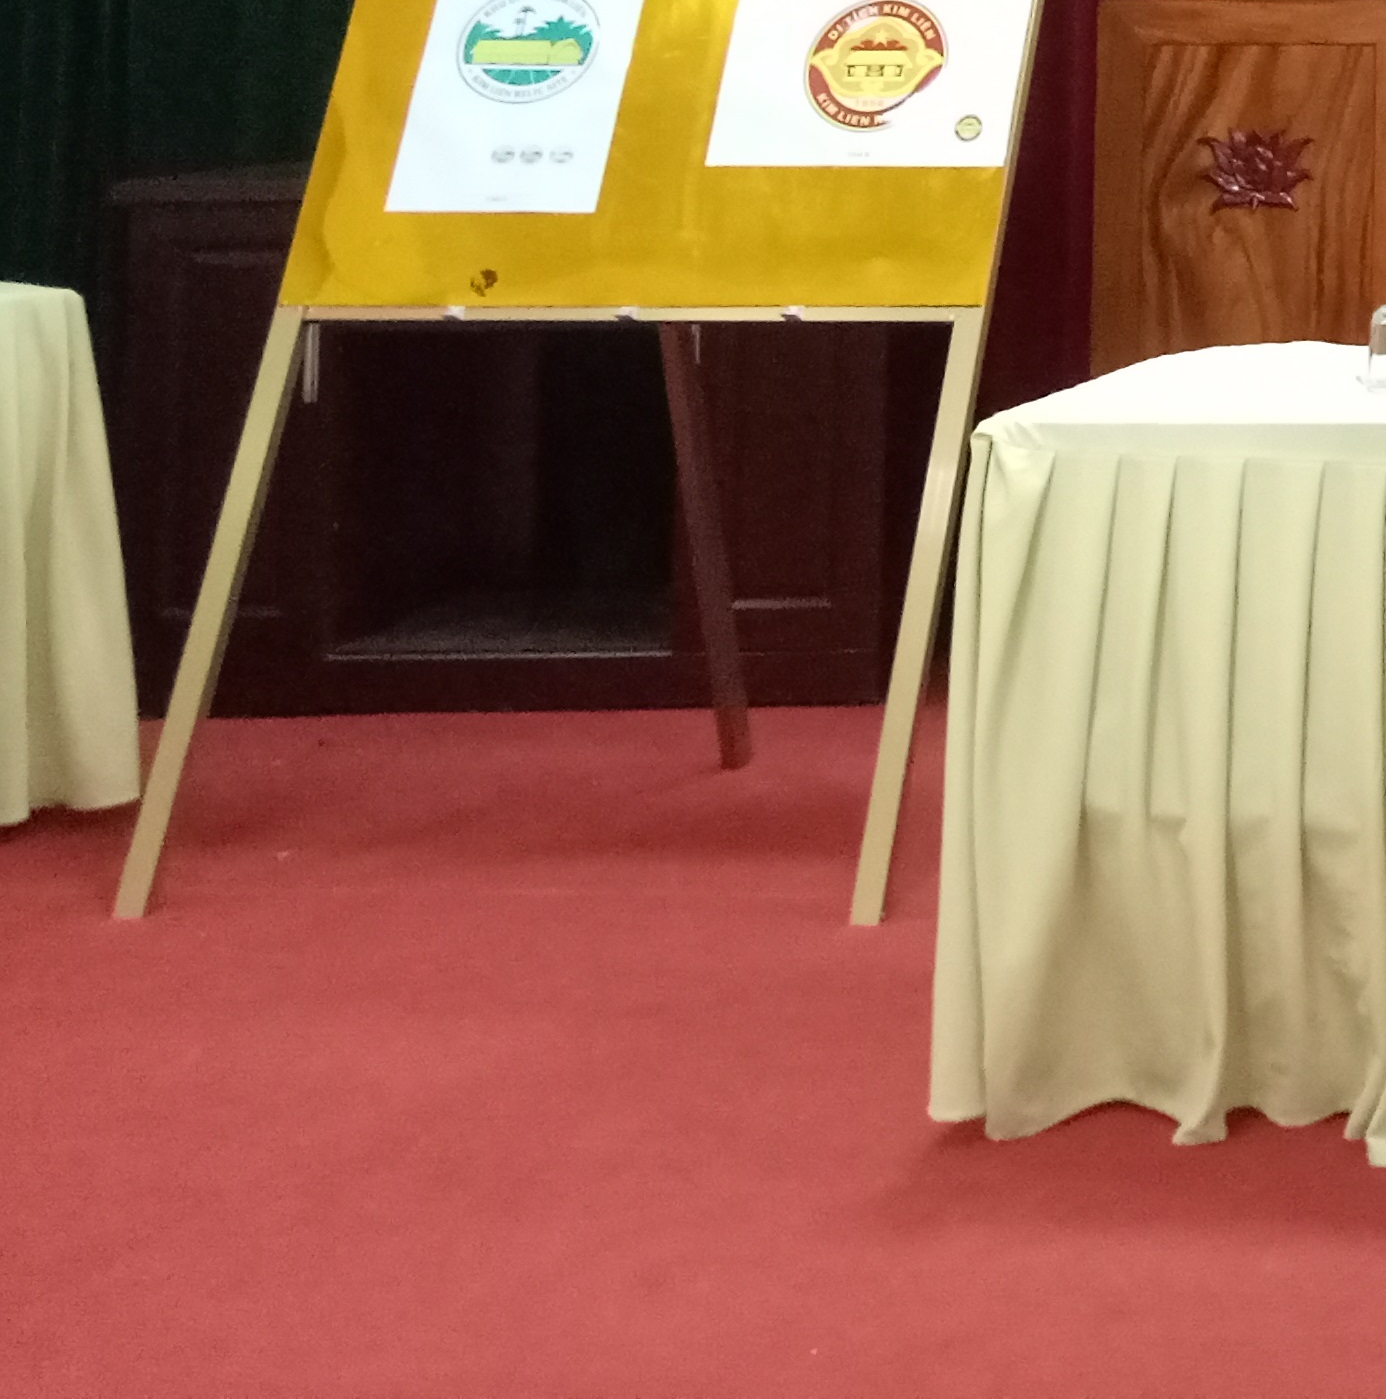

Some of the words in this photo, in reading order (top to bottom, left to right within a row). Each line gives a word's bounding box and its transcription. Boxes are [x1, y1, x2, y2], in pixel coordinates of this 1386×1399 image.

[827, 23, 844, 41] DI
[882, 3, 911, 17] KIM
[816, 93, 839, 116] KIM
[836, 110, 871, 127] LIEN
